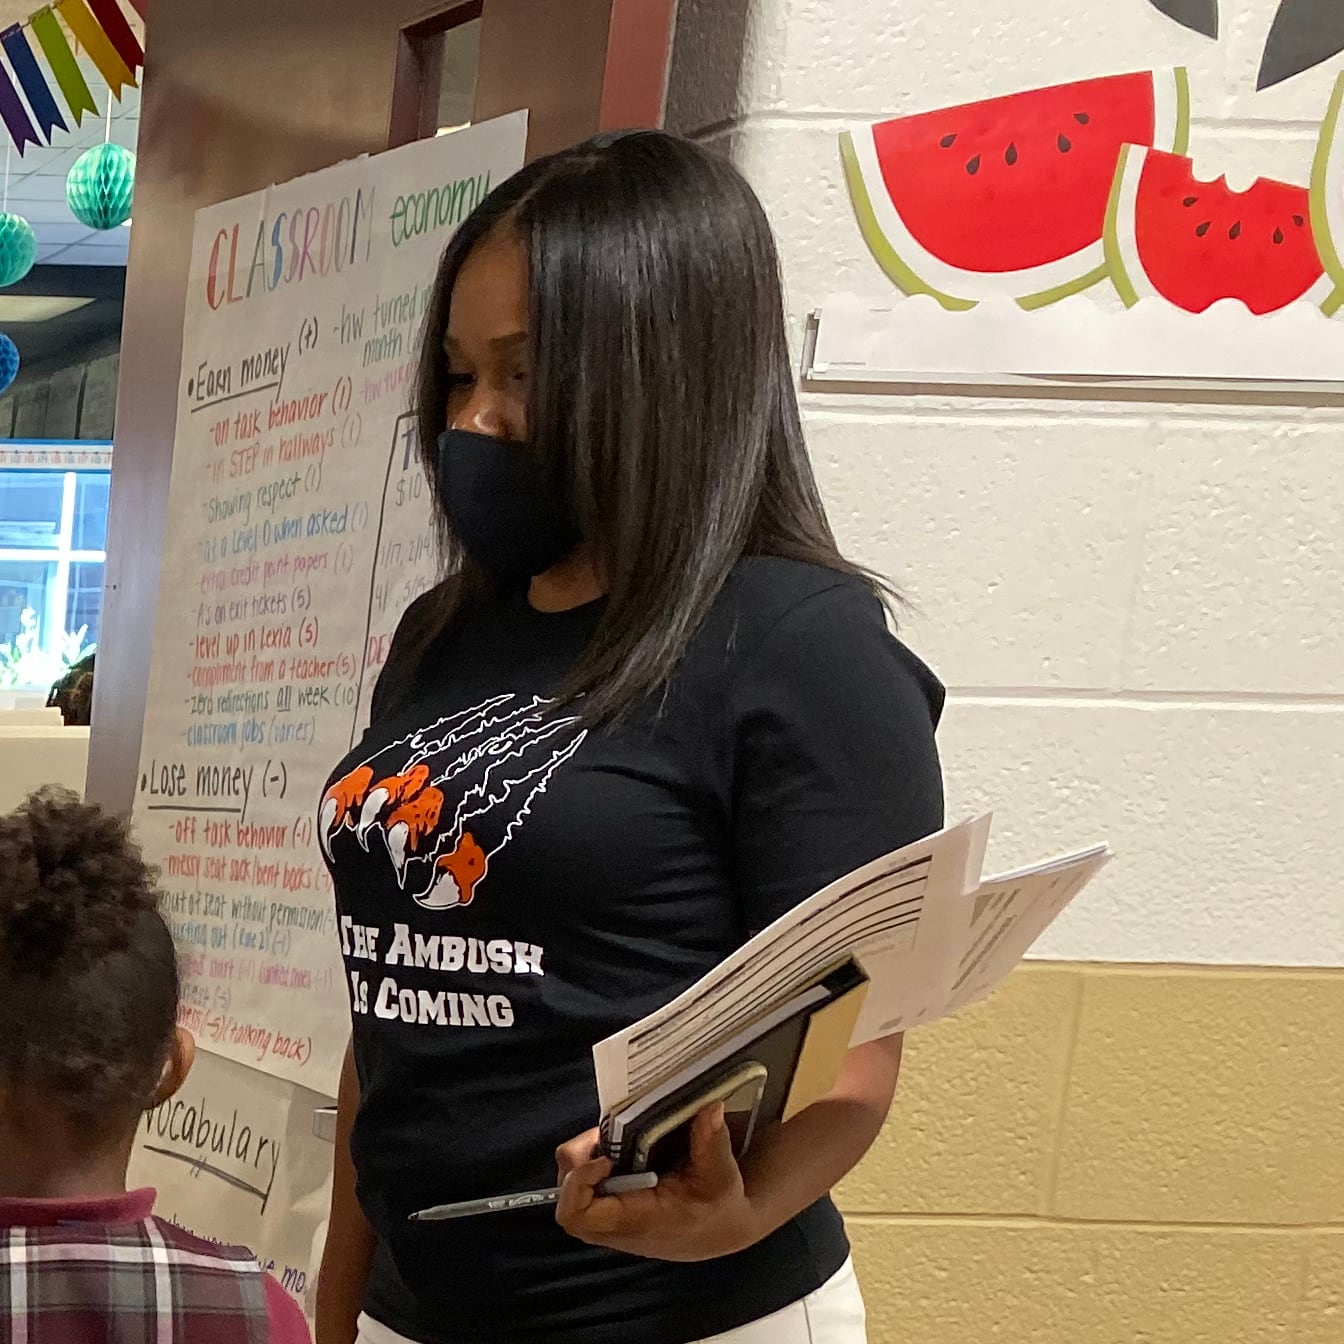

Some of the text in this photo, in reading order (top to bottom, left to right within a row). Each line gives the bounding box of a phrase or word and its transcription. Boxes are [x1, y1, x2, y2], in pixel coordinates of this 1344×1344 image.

[207, 185, 376, 310] CLASSROOM
[241, 342, 291, 405] money
[234, 408, 262, 441] task
[268, 391, 328, 431] behavior
[256, 471, 302, 516] respect
[307, 504, 348, 538] asked
[226, 633, 240, 658] up
[298, 615, 319, 648] (5)
[289, 657, 335, 681] teacher
[297, 684, 330, 708] week
[150, 759, 187, 797] Lose
[196, 764, 254, 825] money
[203, 819, 231, 848] task
[236, 822, 288, 851] behavior
[385, 922, 544, 977] AMBUSH
[374, 977, 515, 1028] COMING
